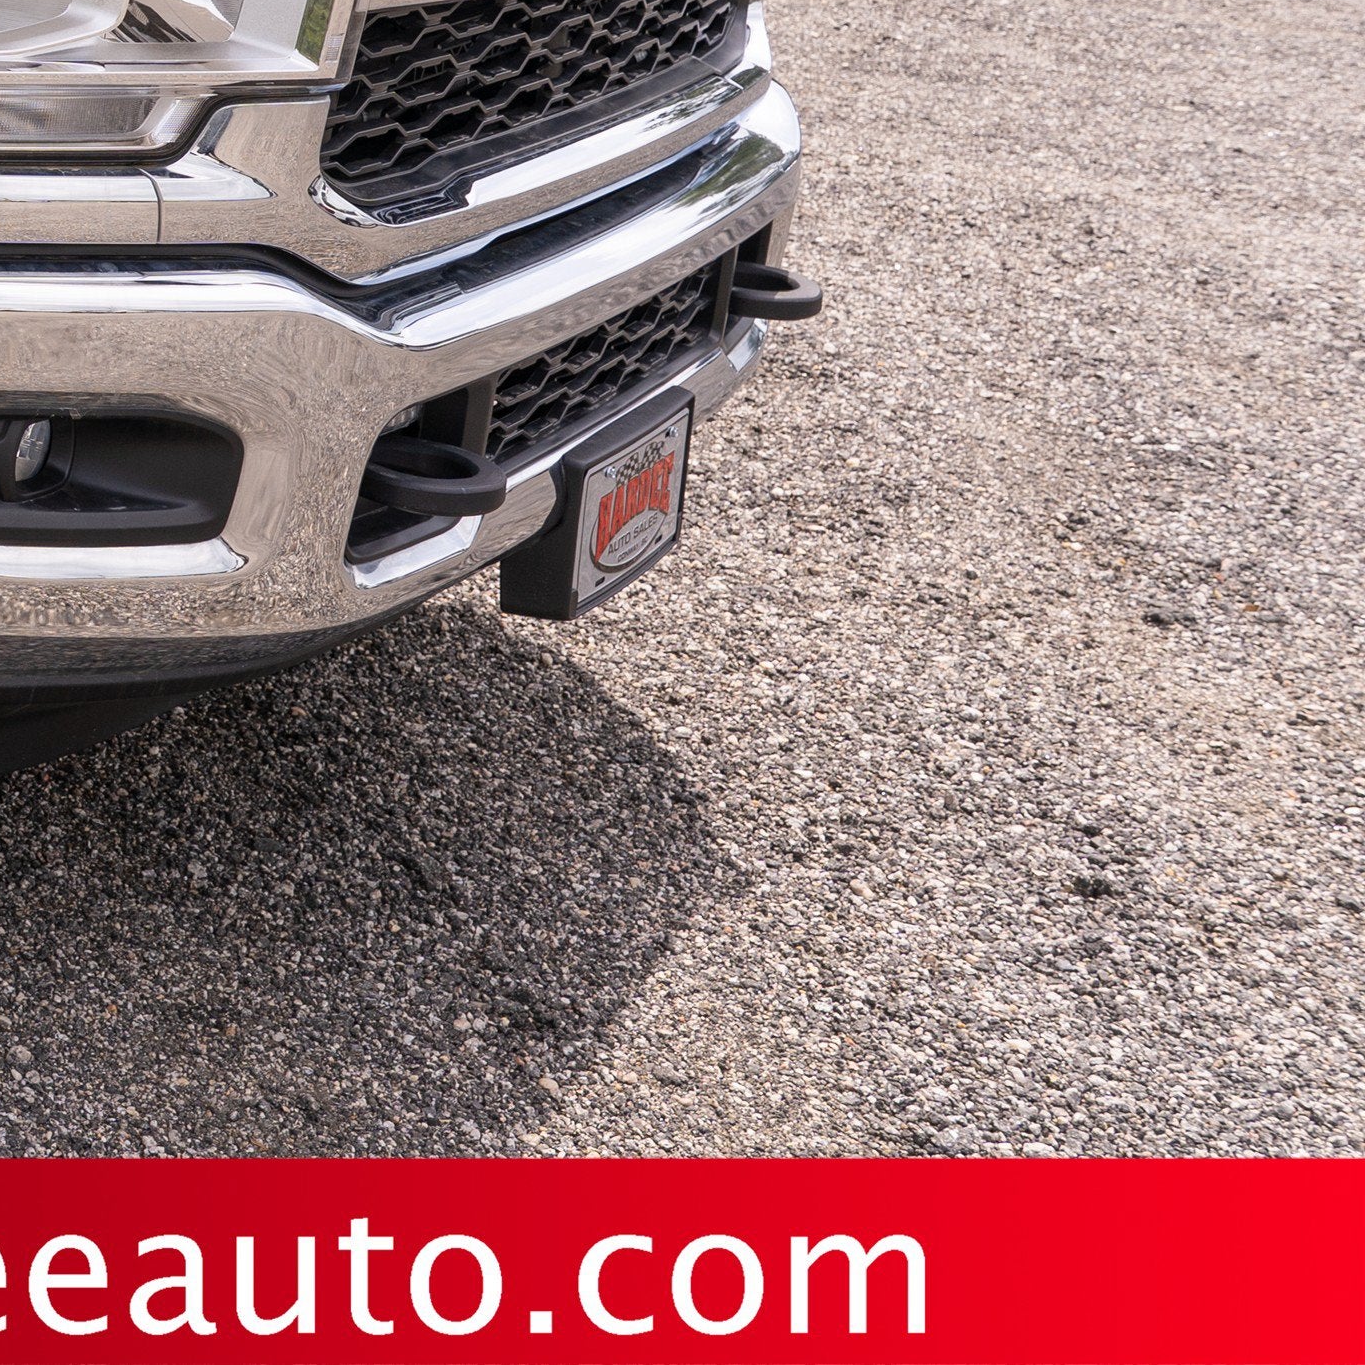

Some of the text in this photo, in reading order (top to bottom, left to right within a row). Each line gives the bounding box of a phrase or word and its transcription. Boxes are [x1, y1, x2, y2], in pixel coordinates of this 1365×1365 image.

[594, 450, 675, 565] HARDEE
[608, 512, 658, 555] AUTO SALES
